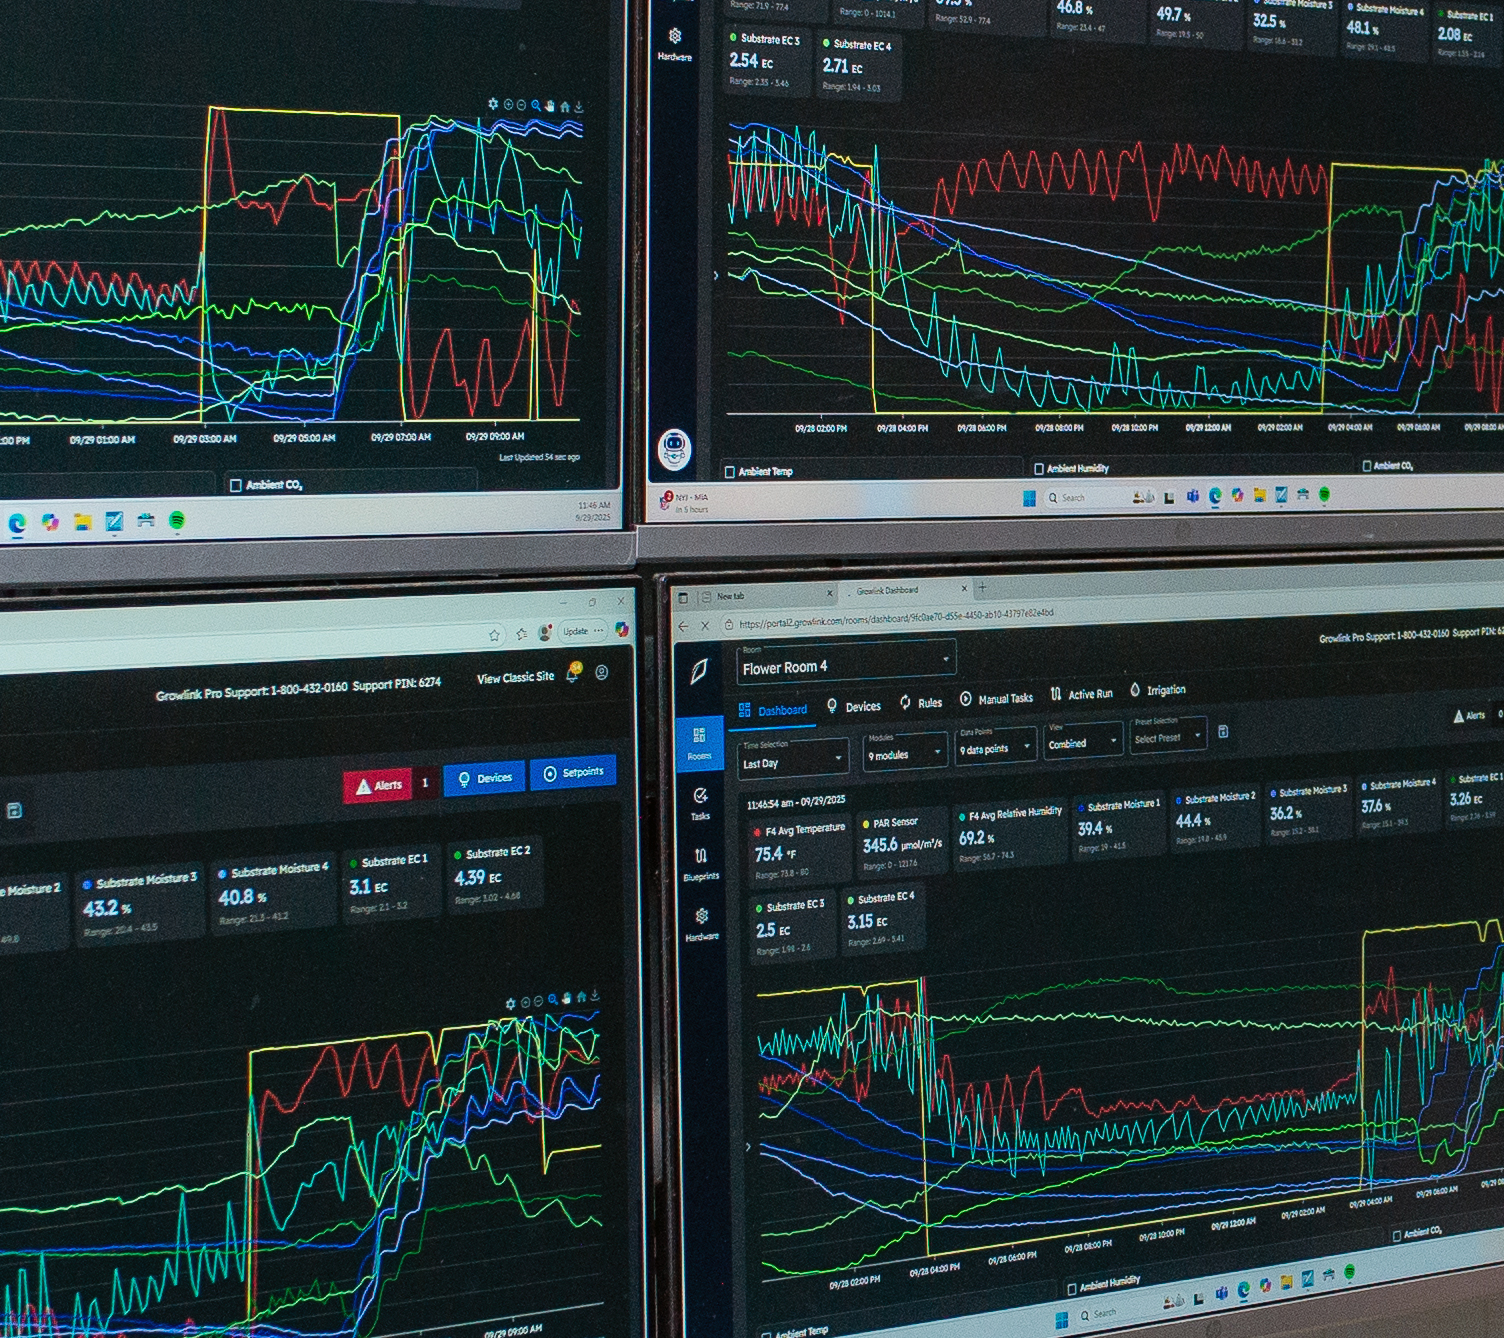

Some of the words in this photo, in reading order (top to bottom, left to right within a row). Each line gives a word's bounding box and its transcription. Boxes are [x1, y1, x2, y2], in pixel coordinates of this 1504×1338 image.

[743, 663, 782, 675] Flower
[784, 661, 818, 673] Room
[820, 660, 828, 671] 4
[477, 674, 501, 684] View
[502, 671, 534, 683] Classic
[536, 671, 555, 681] Site
[1147, 684, 1186, 698] Irrigation
[563, 766, 604, 778] Setpoints
[375, 781, 402, 790] Alerts
[422, 778, 429, 787] 1
[959, 830, 985, 845] 69.2
[863, 837, 898, 853] 345.6
[755, 846, 783, 862] 75.4
